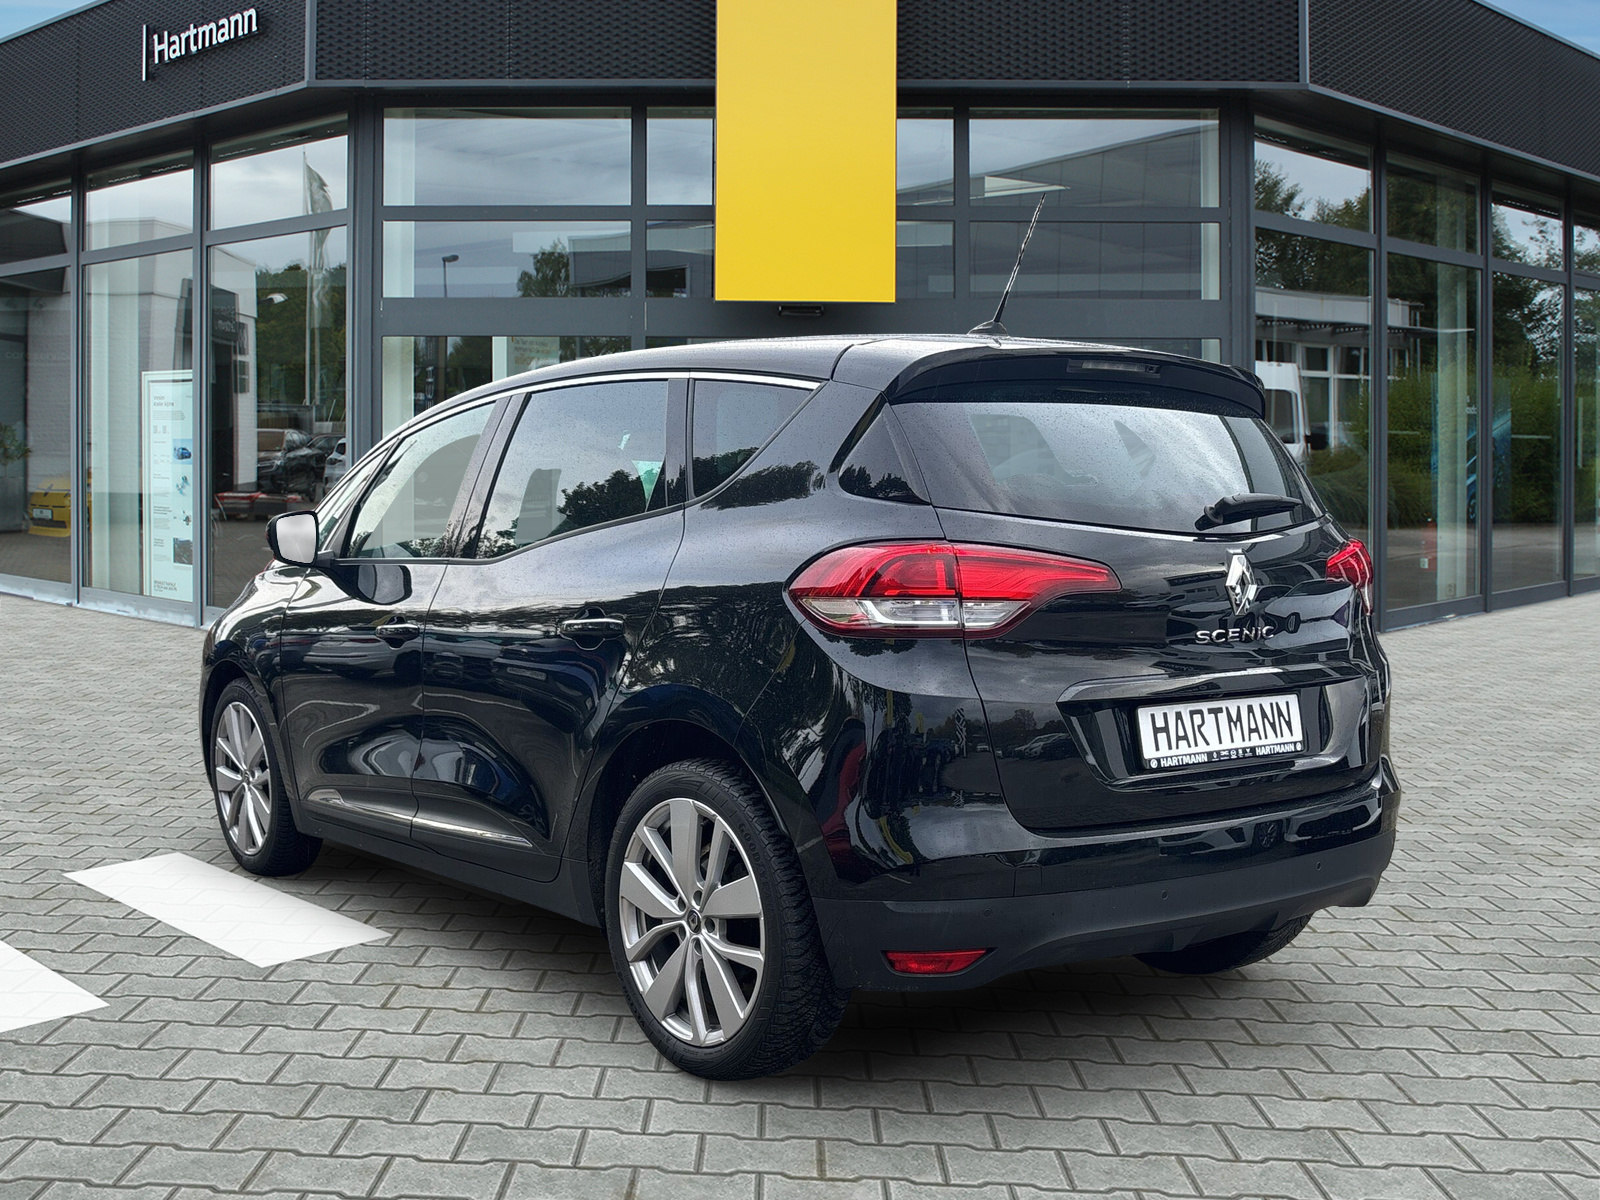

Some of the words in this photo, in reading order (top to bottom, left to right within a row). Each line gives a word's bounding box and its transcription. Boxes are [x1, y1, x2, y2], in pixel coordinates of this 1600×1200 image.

[153, 8, 258, 64] Hartmann
[1195, 625, 1275, 644] SCENIC
[1150, 700, 1294, 752] HARTMANN
[1160, 751, 1208, 768] HARTMANN
[1255, 742, 1295, 756] HARTMANN
